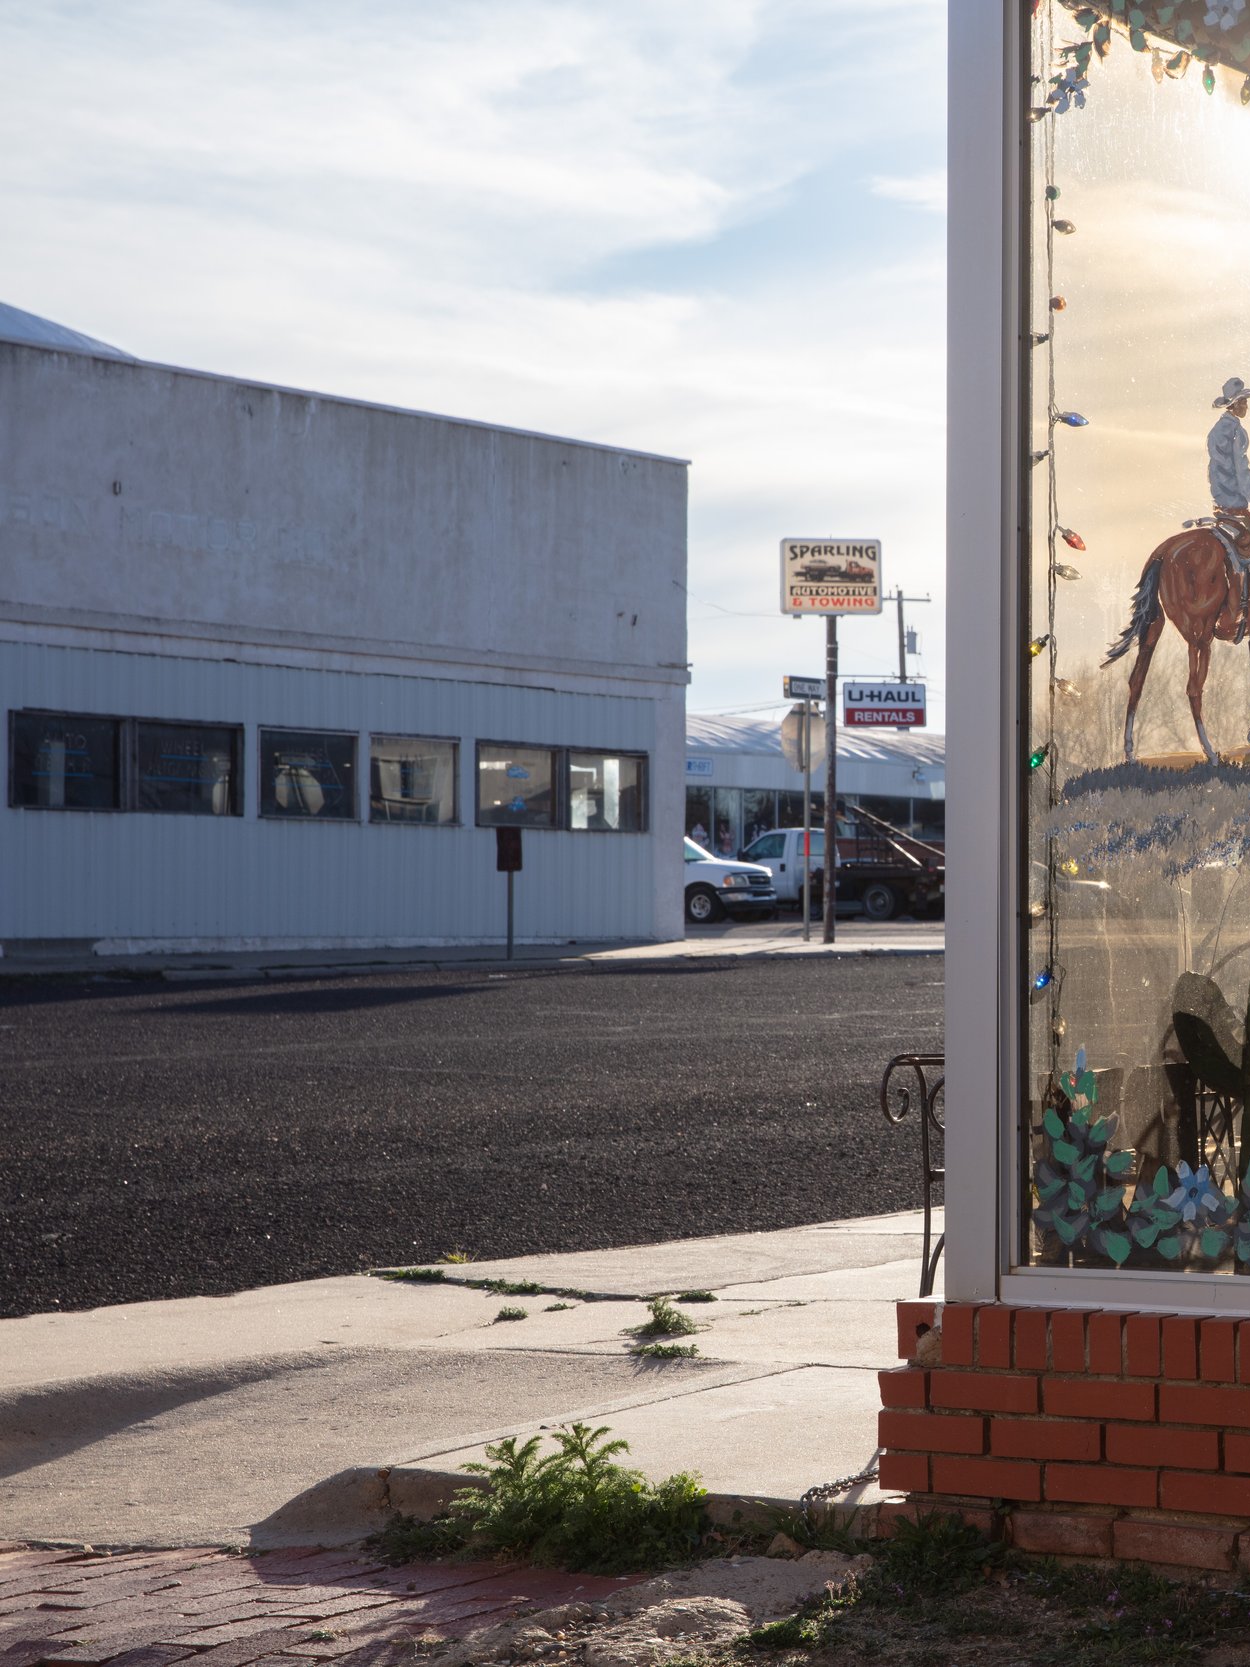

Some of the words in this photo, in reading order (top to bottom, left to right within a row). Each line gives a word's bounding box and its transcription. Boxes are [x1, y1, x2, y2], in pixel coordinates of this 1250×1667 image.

[789, 545, 877, 562] SPARLING
[792, 586, 874, 596] AUTOMOTIVE
[792, 597, 802, 607] &
[809, 597, 875, 607] TOWING
[793, 682, 807, 692] ONE
[808, 685, 820, 694] WAY
[848, 689, 922, 703] U-HAUL
[854, 711, 915, 723] RENTALS
